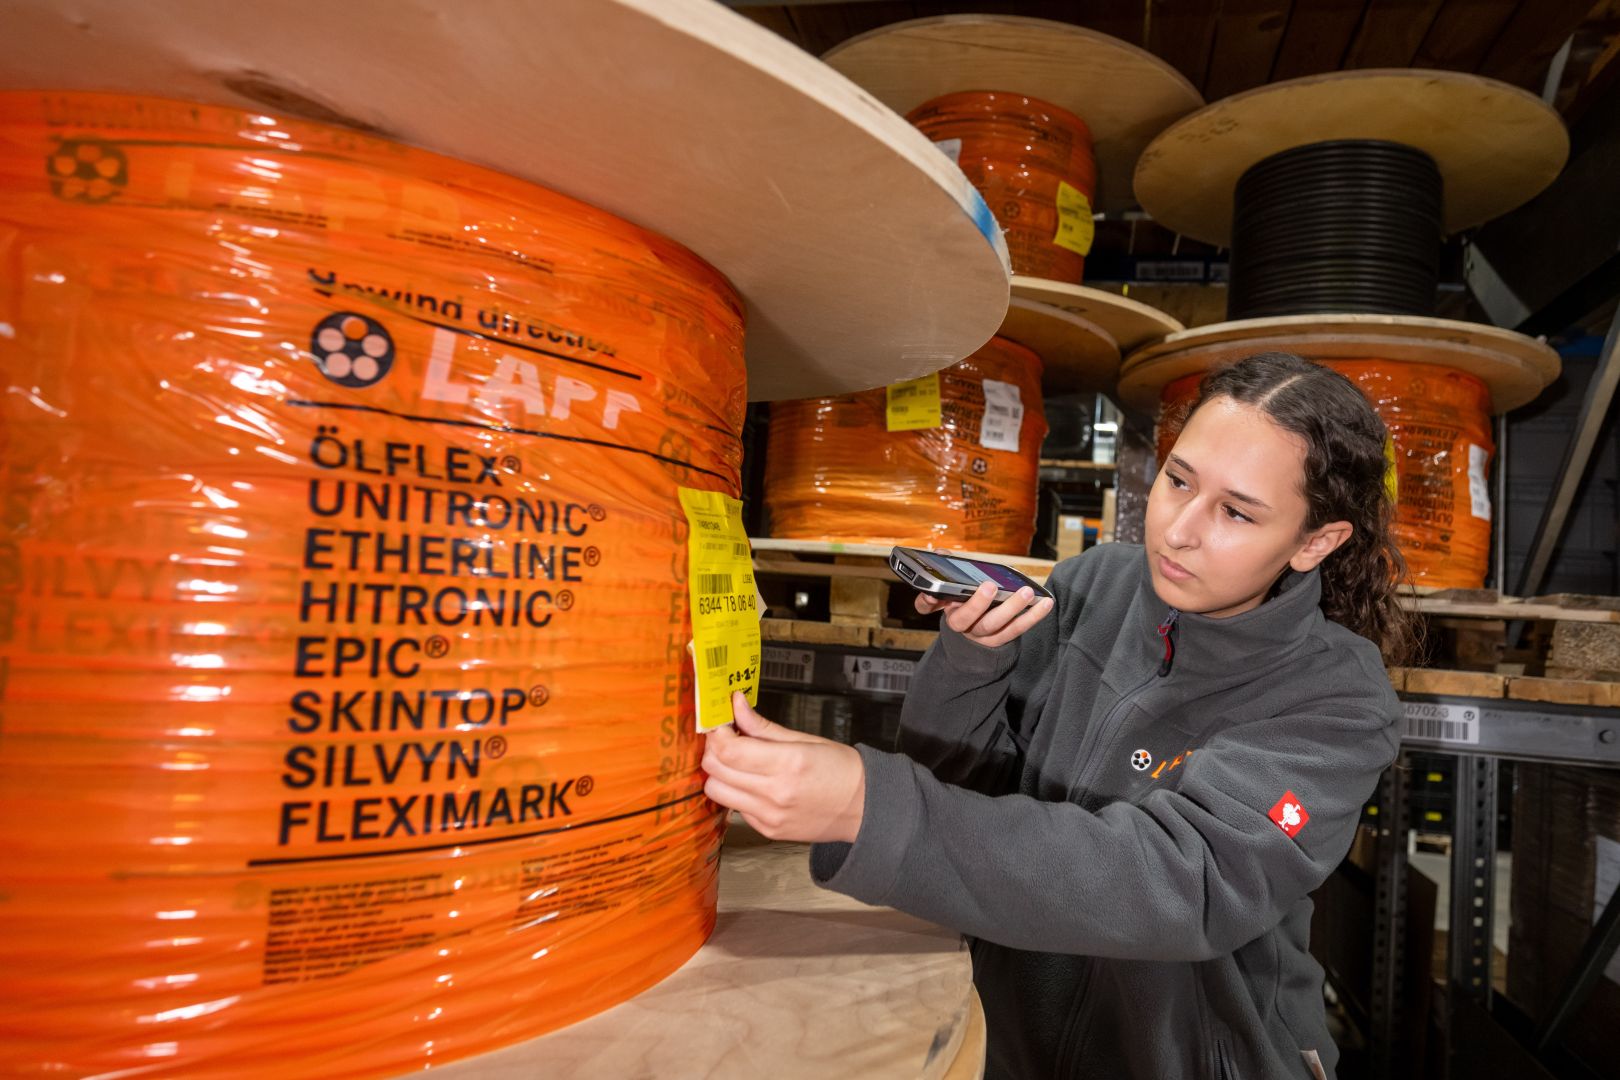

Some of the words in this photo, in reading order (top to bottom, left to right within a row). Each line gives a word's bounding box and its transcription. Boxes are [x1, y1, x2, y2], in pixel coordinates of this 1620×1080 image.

[699, 597, 723, 616] 6344
[724, 595, 737, 613] 78
[1403, 704, 1450, 719] 0702-3
